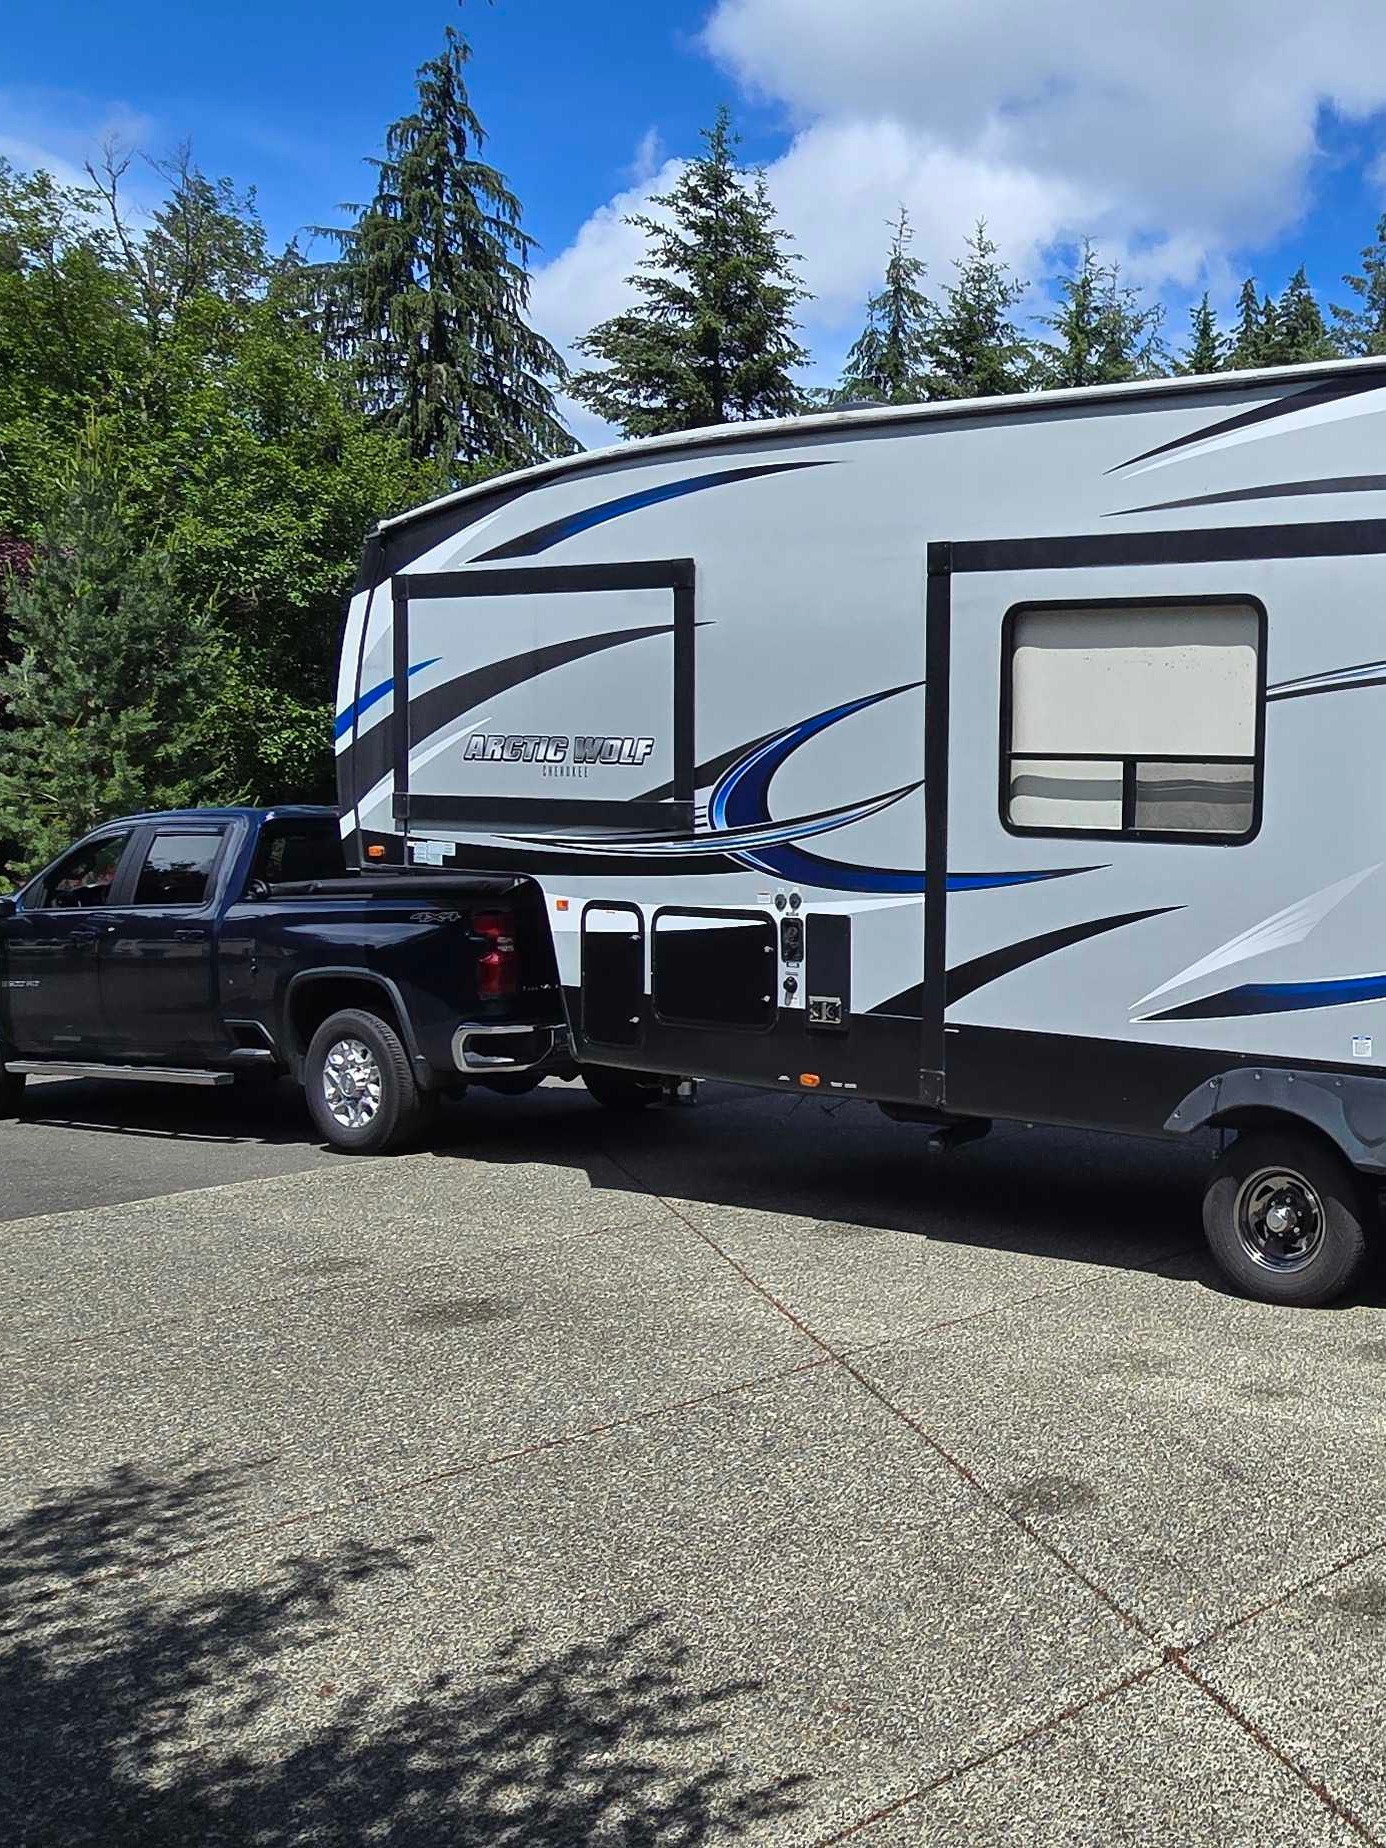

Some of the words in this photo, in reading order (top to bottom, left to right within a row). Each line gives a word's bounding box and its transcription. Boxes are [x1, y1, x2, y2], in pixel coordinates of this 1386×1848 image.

[463, 734, 569, 763] ARCTIC
[573, 736, 655, 766] WOLF
[542, 765, 588, 778] CHEROKEE
